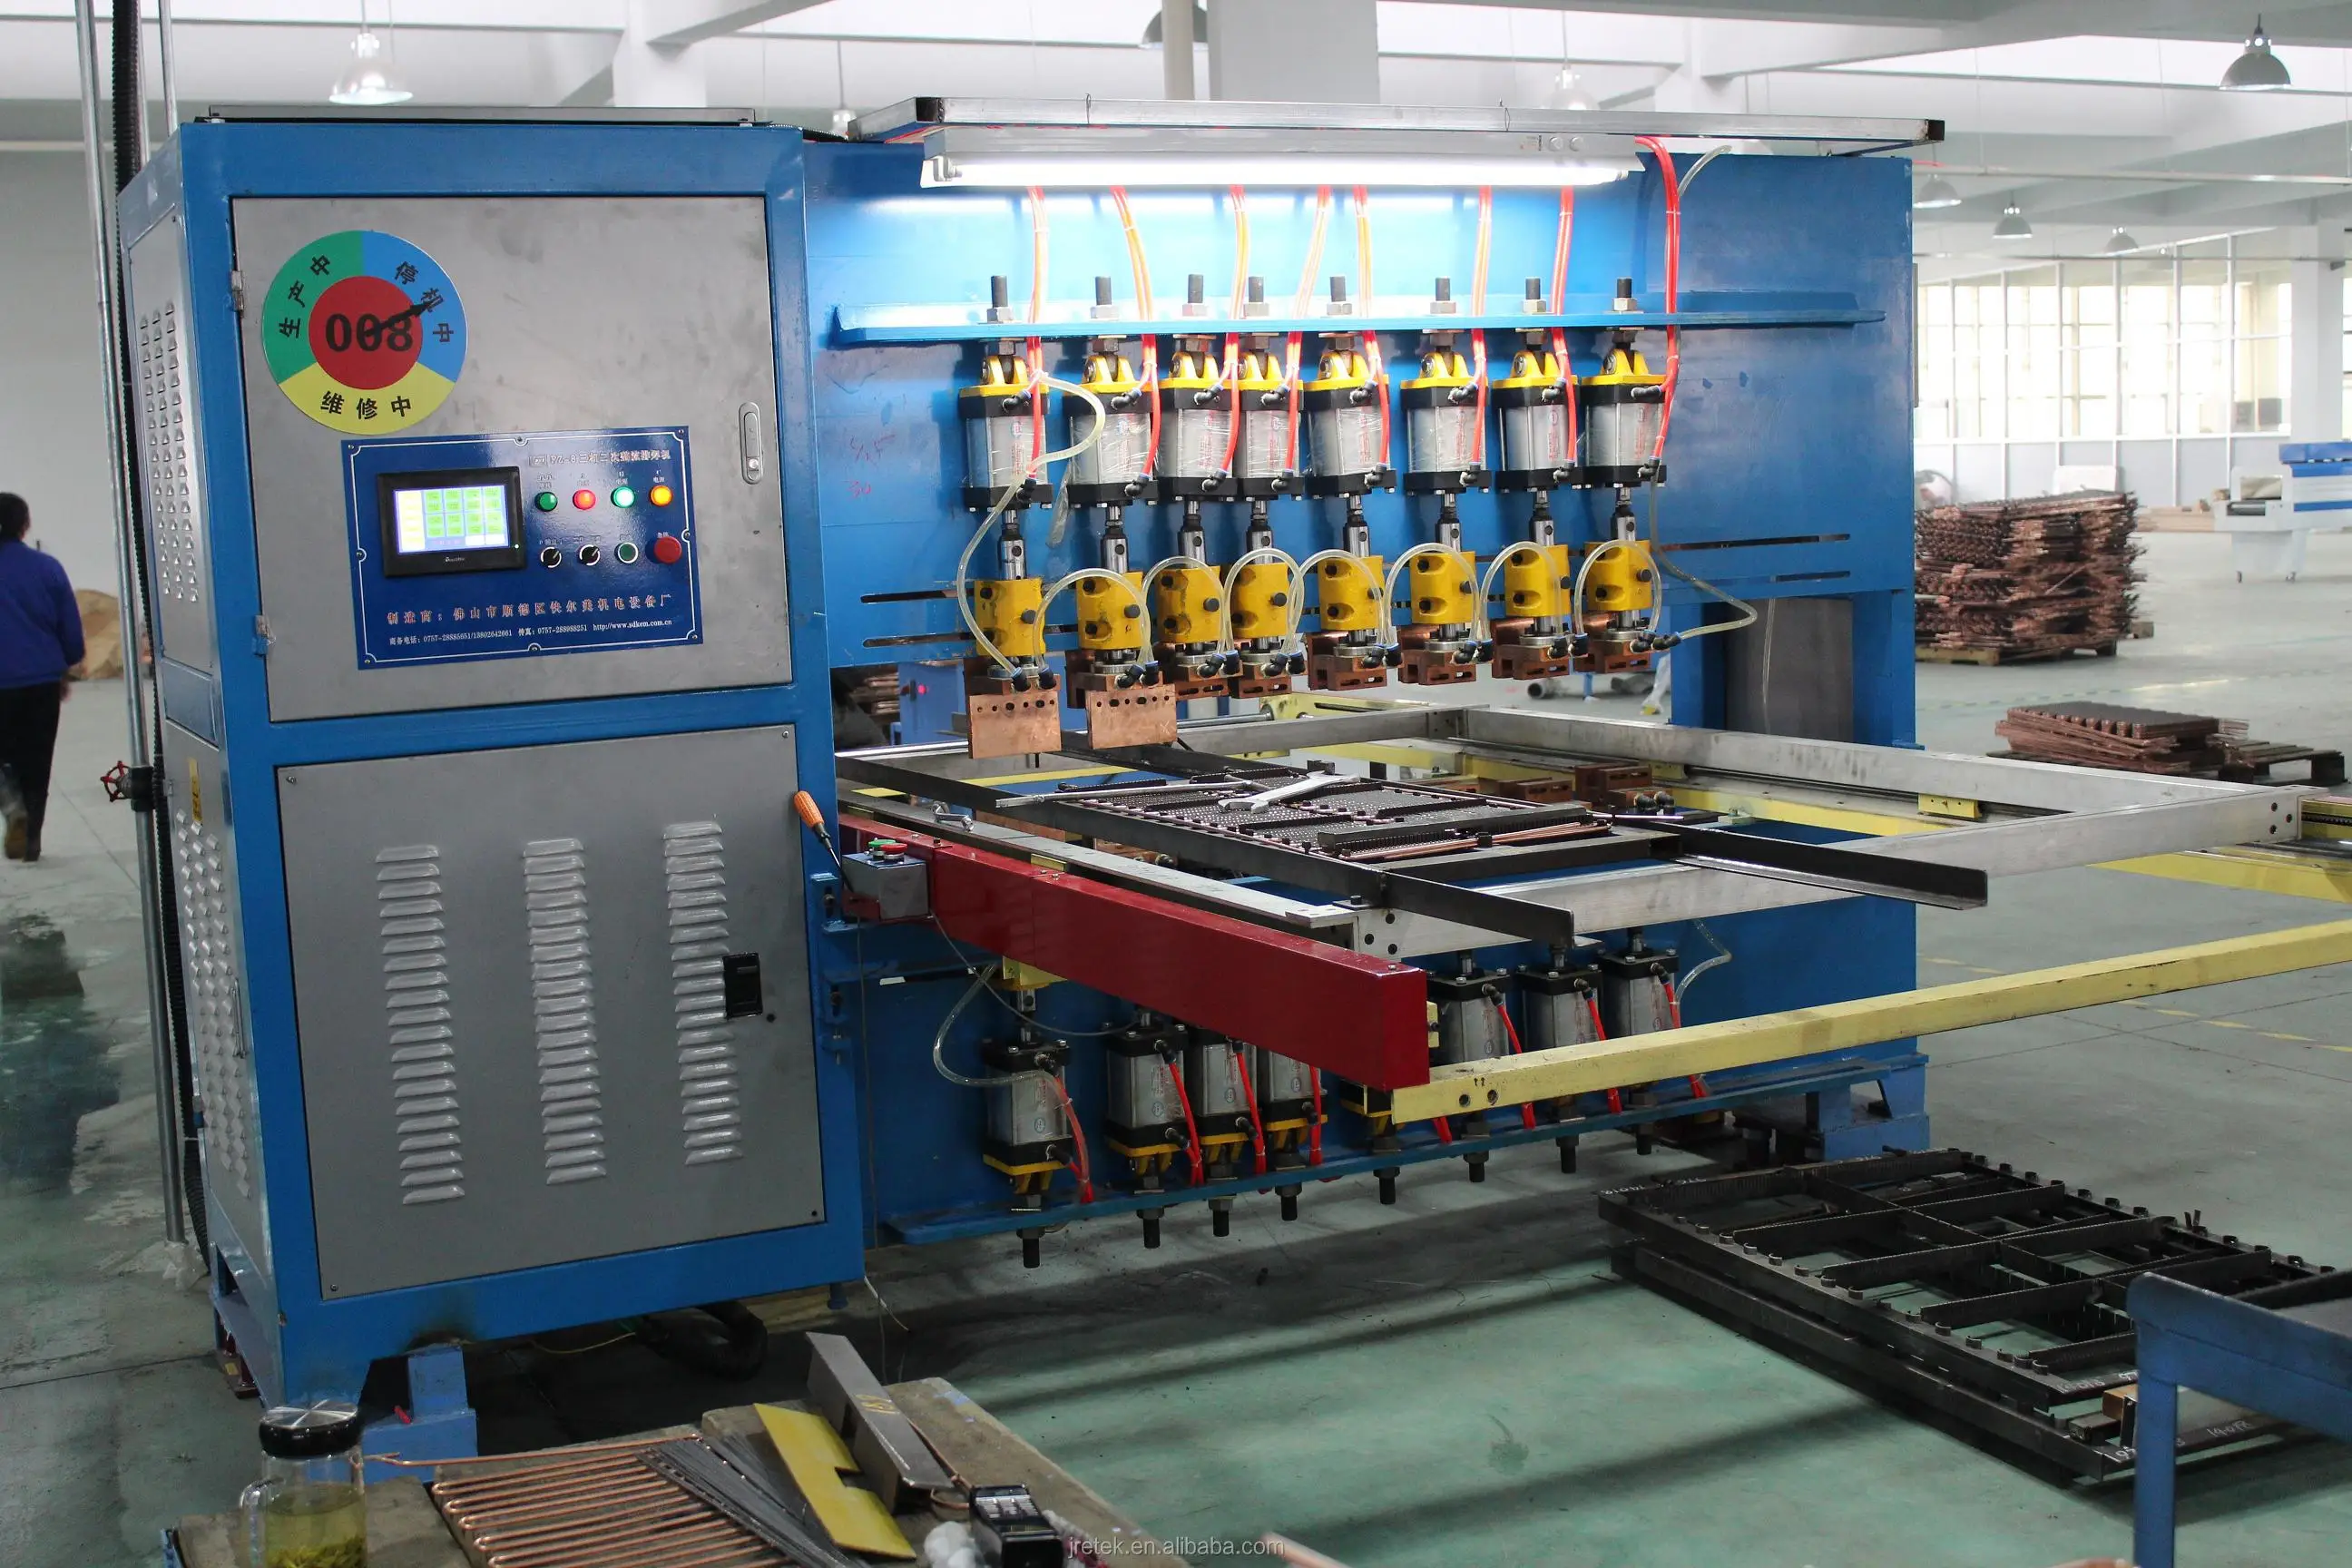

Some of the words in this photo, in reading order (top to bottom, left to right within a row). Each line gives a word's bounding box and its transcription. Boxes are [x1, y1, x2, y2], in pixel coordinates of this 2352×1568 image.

[279, 255, 330, 339] 生产中
[394, 260, 454, 342] 停机中
[326, 313, 413, 352] 008
[320, 391, 411, 419] 维修中
